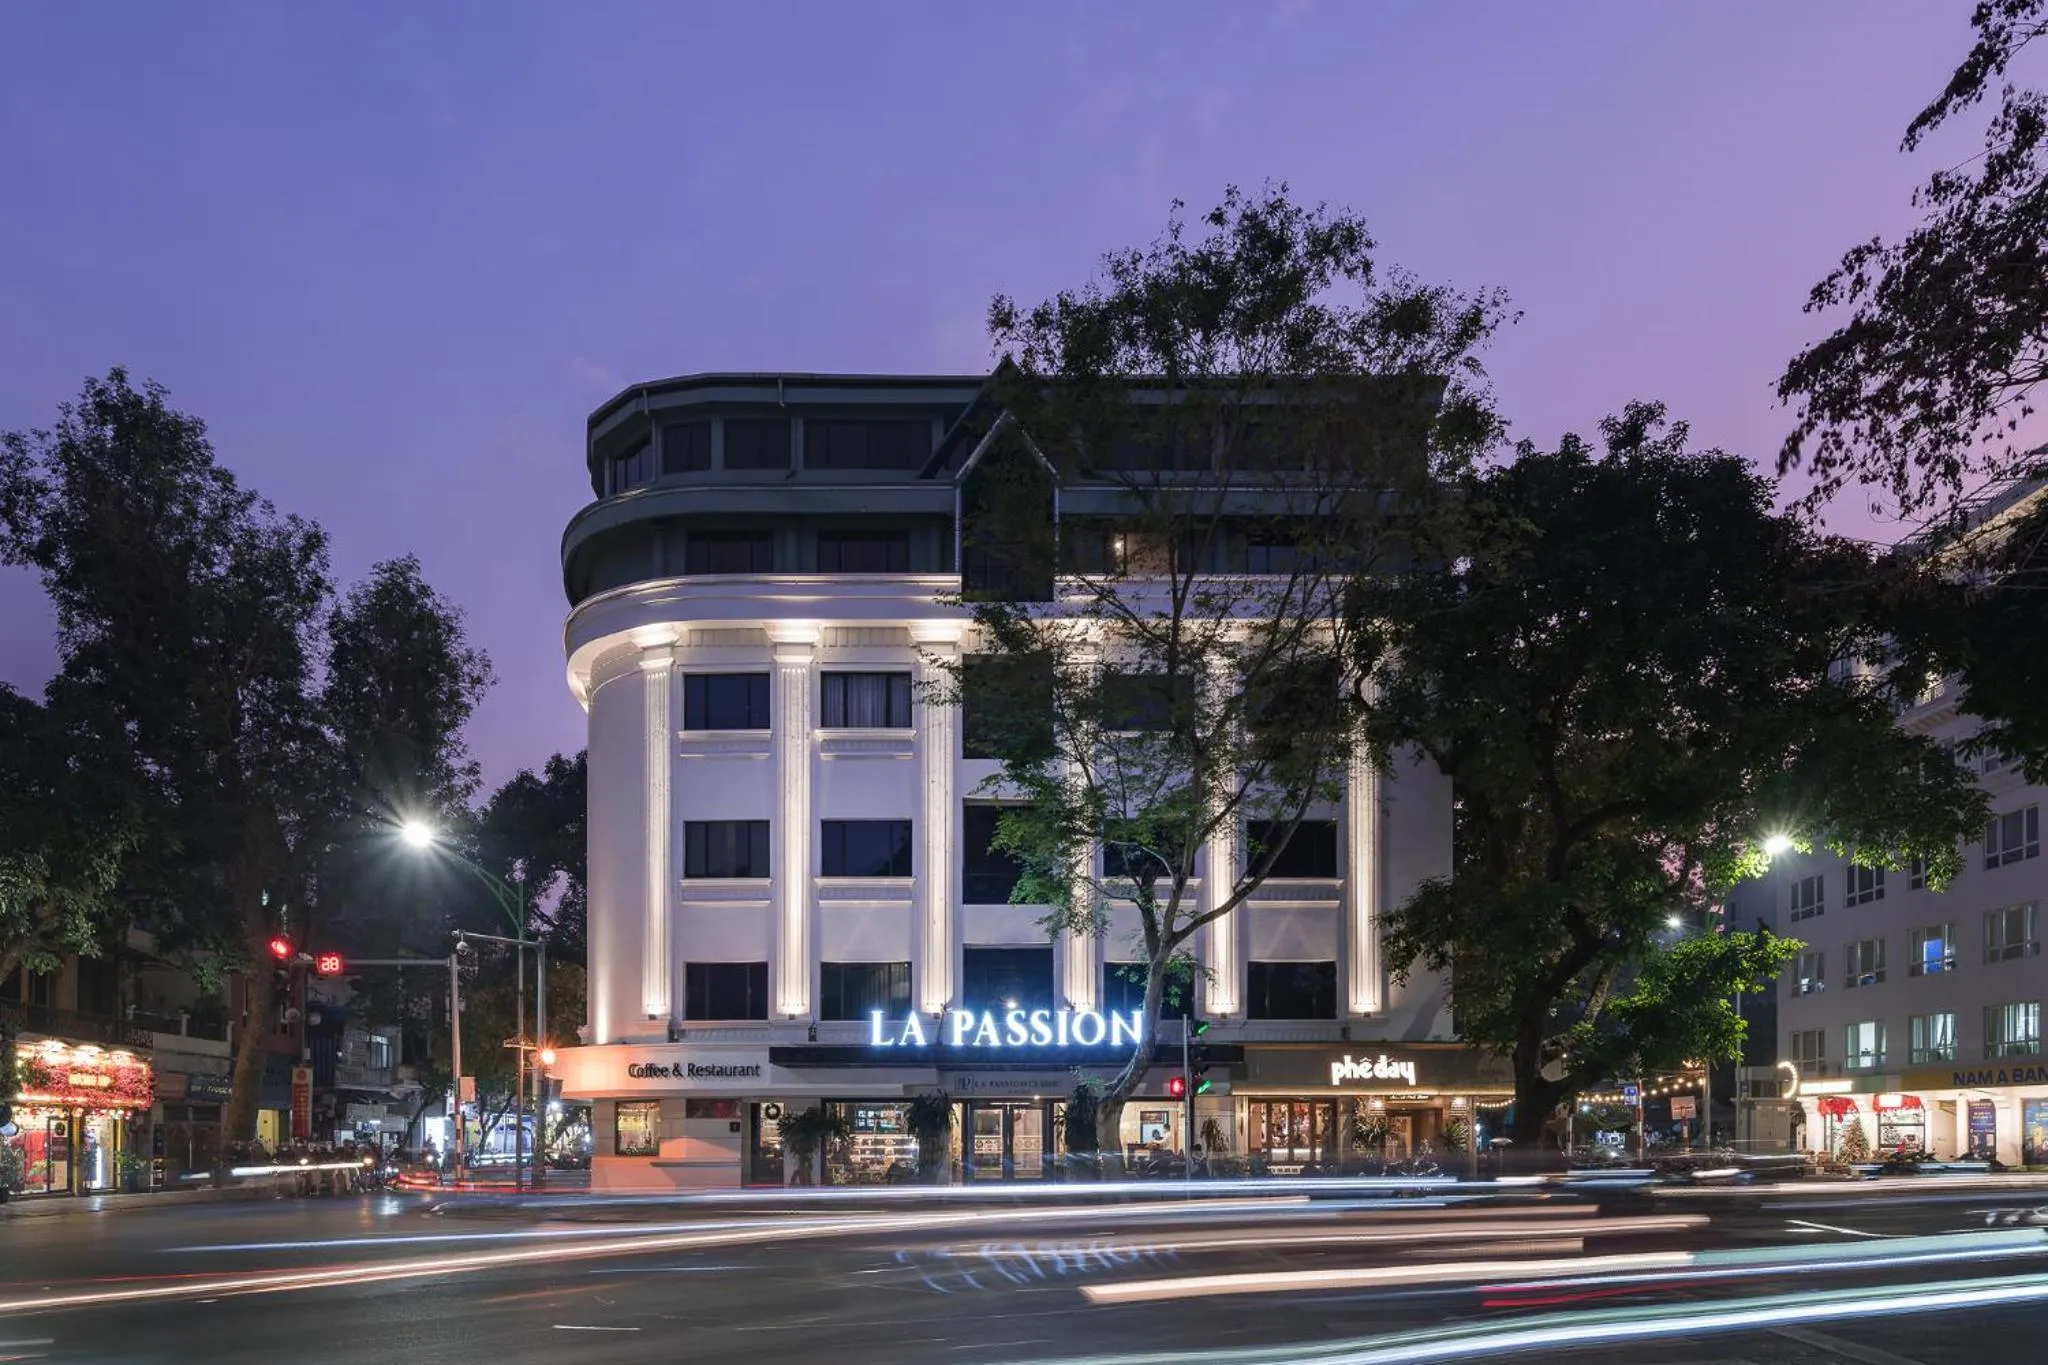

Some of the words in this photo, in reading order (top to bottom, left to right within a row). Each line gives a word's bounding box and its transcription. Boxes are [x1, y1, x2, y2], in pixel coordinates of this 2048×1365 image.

[870, 1009, 928, 1047] LA
[951, 1009, 1143, 1047] PASSION
[628, 1063, 669, 1078] Coffee
[672, 1063, 684, 1077] &
[687, 1063, 761, 1077] Restaurant
[1953, 1070, 1993, 1086] NAM
[1997, 1069, 2008, 1084] A
